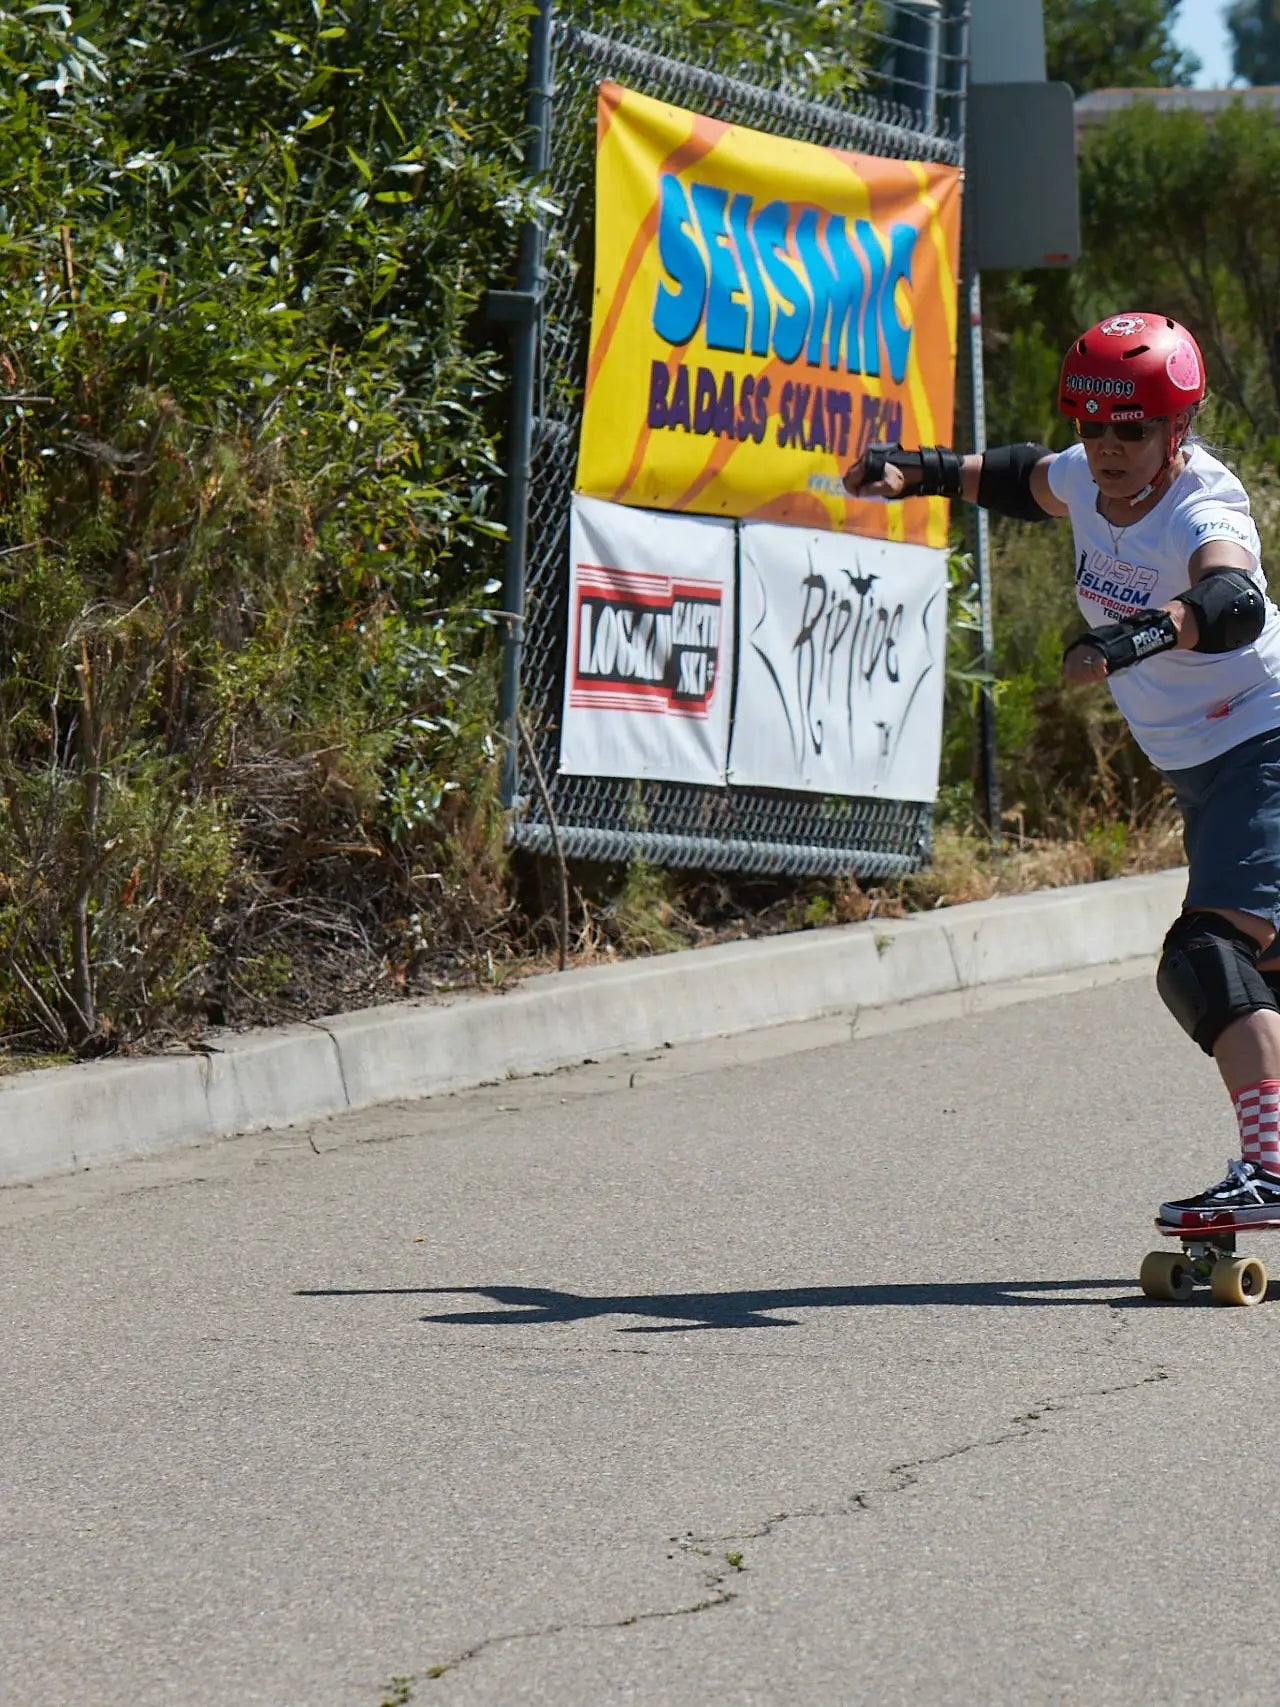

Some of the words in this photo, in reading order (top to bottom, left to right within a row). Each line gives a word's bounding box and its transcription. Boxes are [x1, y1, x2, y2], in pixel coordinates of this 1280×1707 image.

[651, 172, 918, 386] SEISMIC
[648, 360, 770, 445] BADASS
[776, 380, 853, 458] SKATE
[1111, 410, 1144, 421] GIRO
[1081, 573, 1151, 606] SLALOM
[1088, 550, 1159, 591] USA
